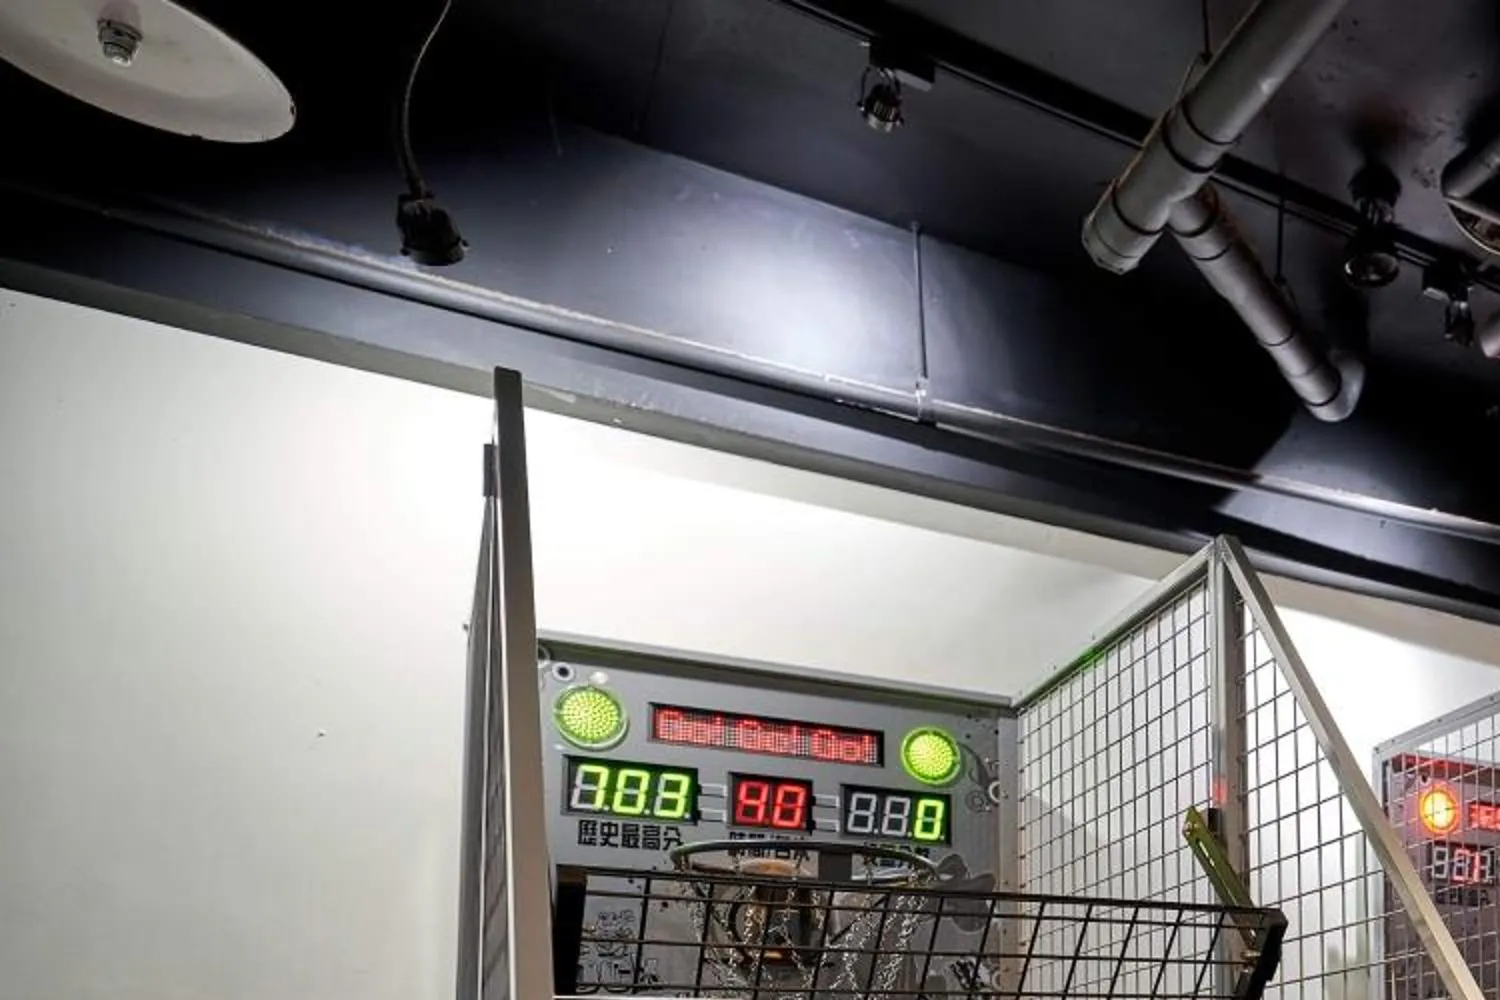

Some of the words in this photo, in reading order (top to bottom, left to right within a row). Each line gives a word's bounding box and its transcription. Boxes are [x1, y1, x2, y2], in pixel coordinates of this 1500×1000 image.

[577, 819, 685, 851] 歷史最高分
